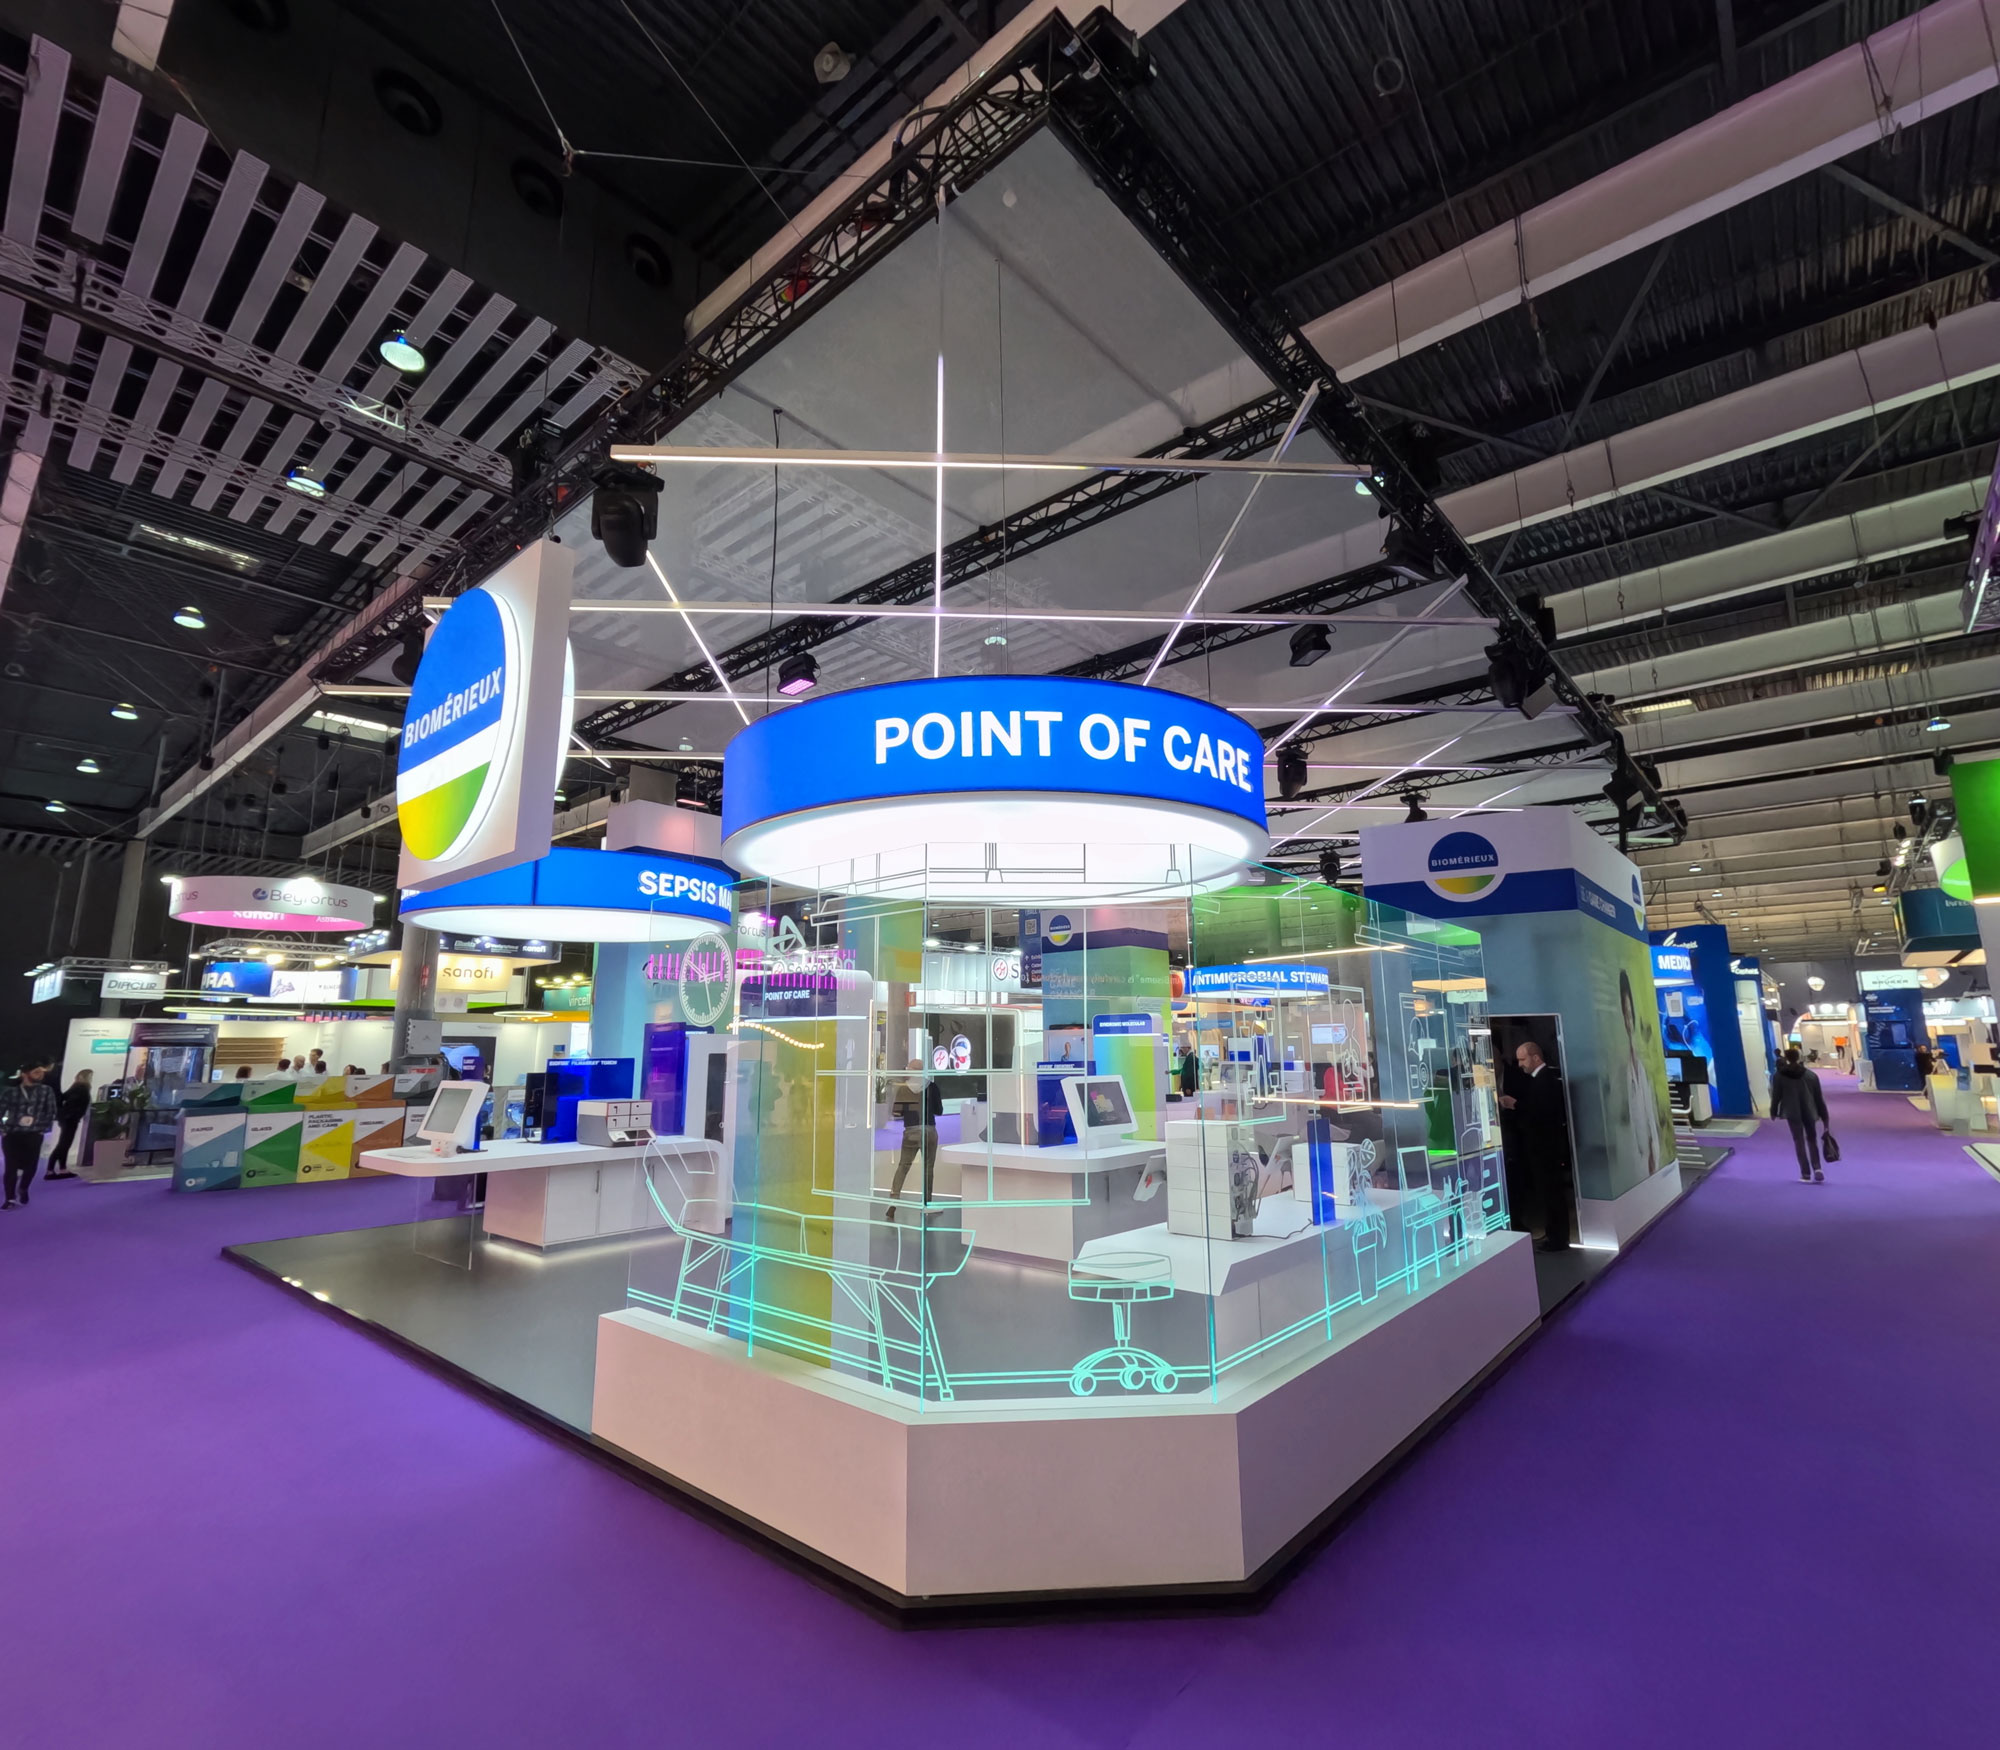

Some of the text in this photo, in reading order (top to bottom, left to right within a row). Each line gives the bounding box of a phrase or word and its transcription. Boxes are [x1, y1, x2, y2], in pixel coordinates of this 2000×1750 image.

[403, 666, 502, 749] BIOMÉRIEUX
[875, 710, 1252, 792] POINT OF CARE
[1431, 854, 1495, 867] BIOMÉRIEUX
[639, 870, 717, 905] SEPSIS
[200, 970, 235, 989] RA
[442, 966, 494, 980] sanofi
[1193, 970, 1288, 986] ANTIMICROBIAL
[764, 990, 810, 1000] POINT OF CARE
